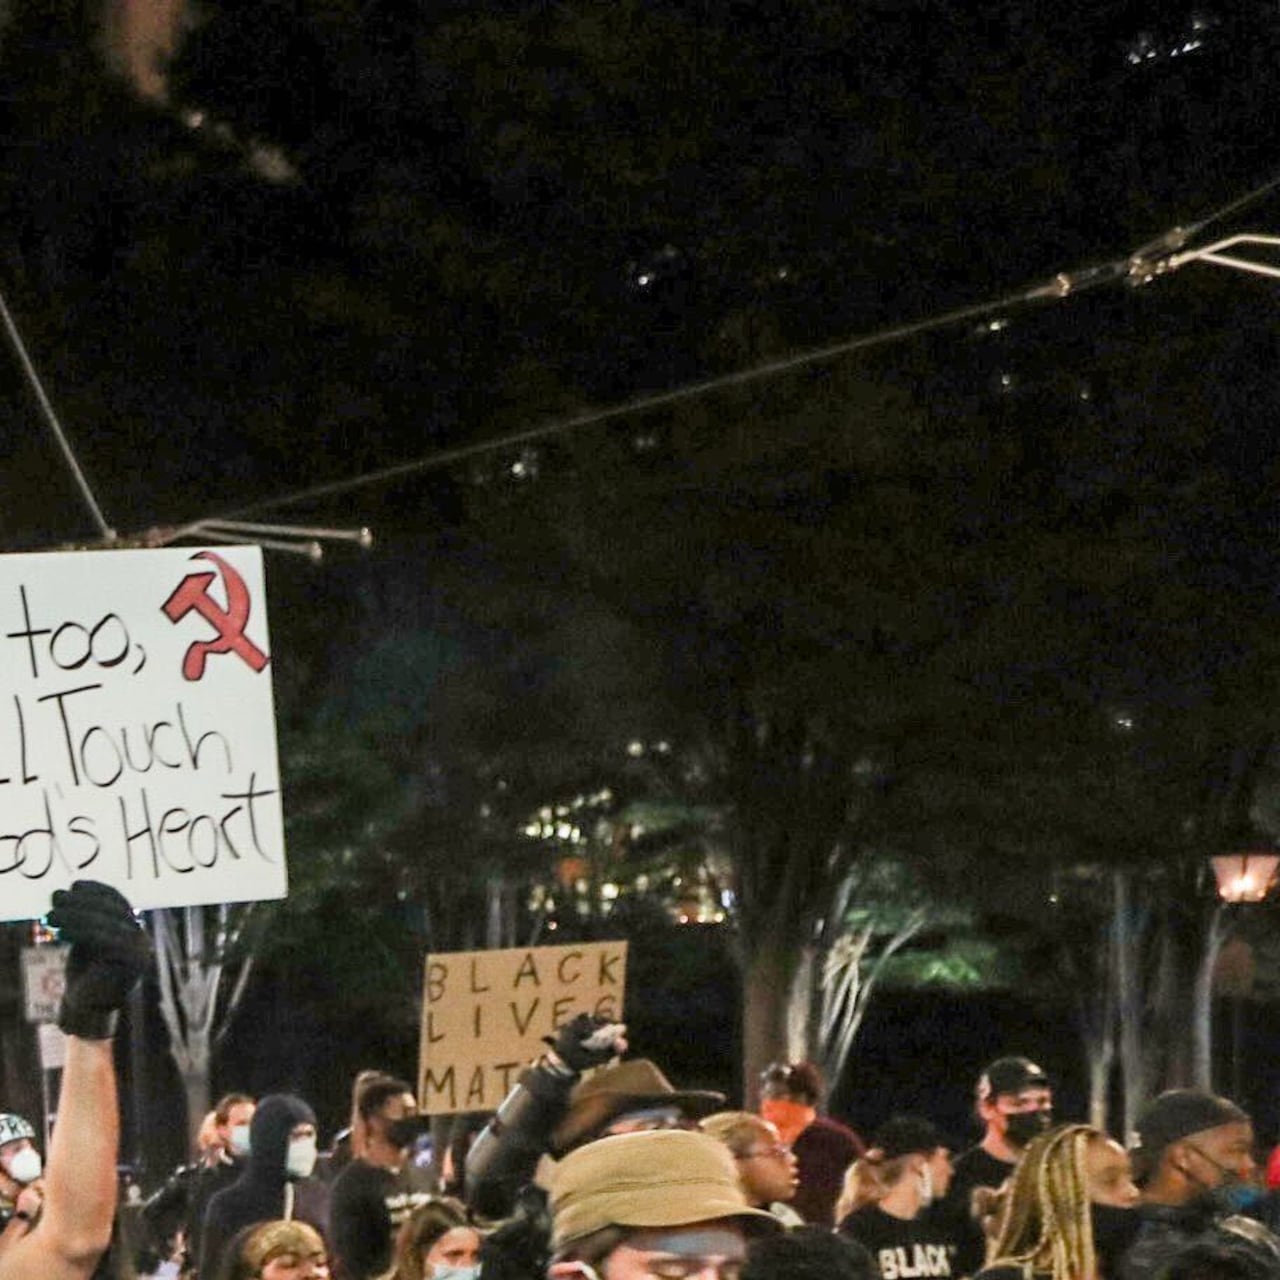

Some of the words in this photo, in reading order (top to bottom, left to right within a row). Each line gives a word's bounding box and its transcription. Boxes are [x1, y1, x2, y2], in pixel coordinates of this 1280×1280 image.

[6, 584, 147, 680] too,
[37, 683, 233, 788] Touch
[118, 771, 278, 882] Heart
[425, 952, 621, 1003] BLACK
[421, 1055, 535, 1109] MAT
